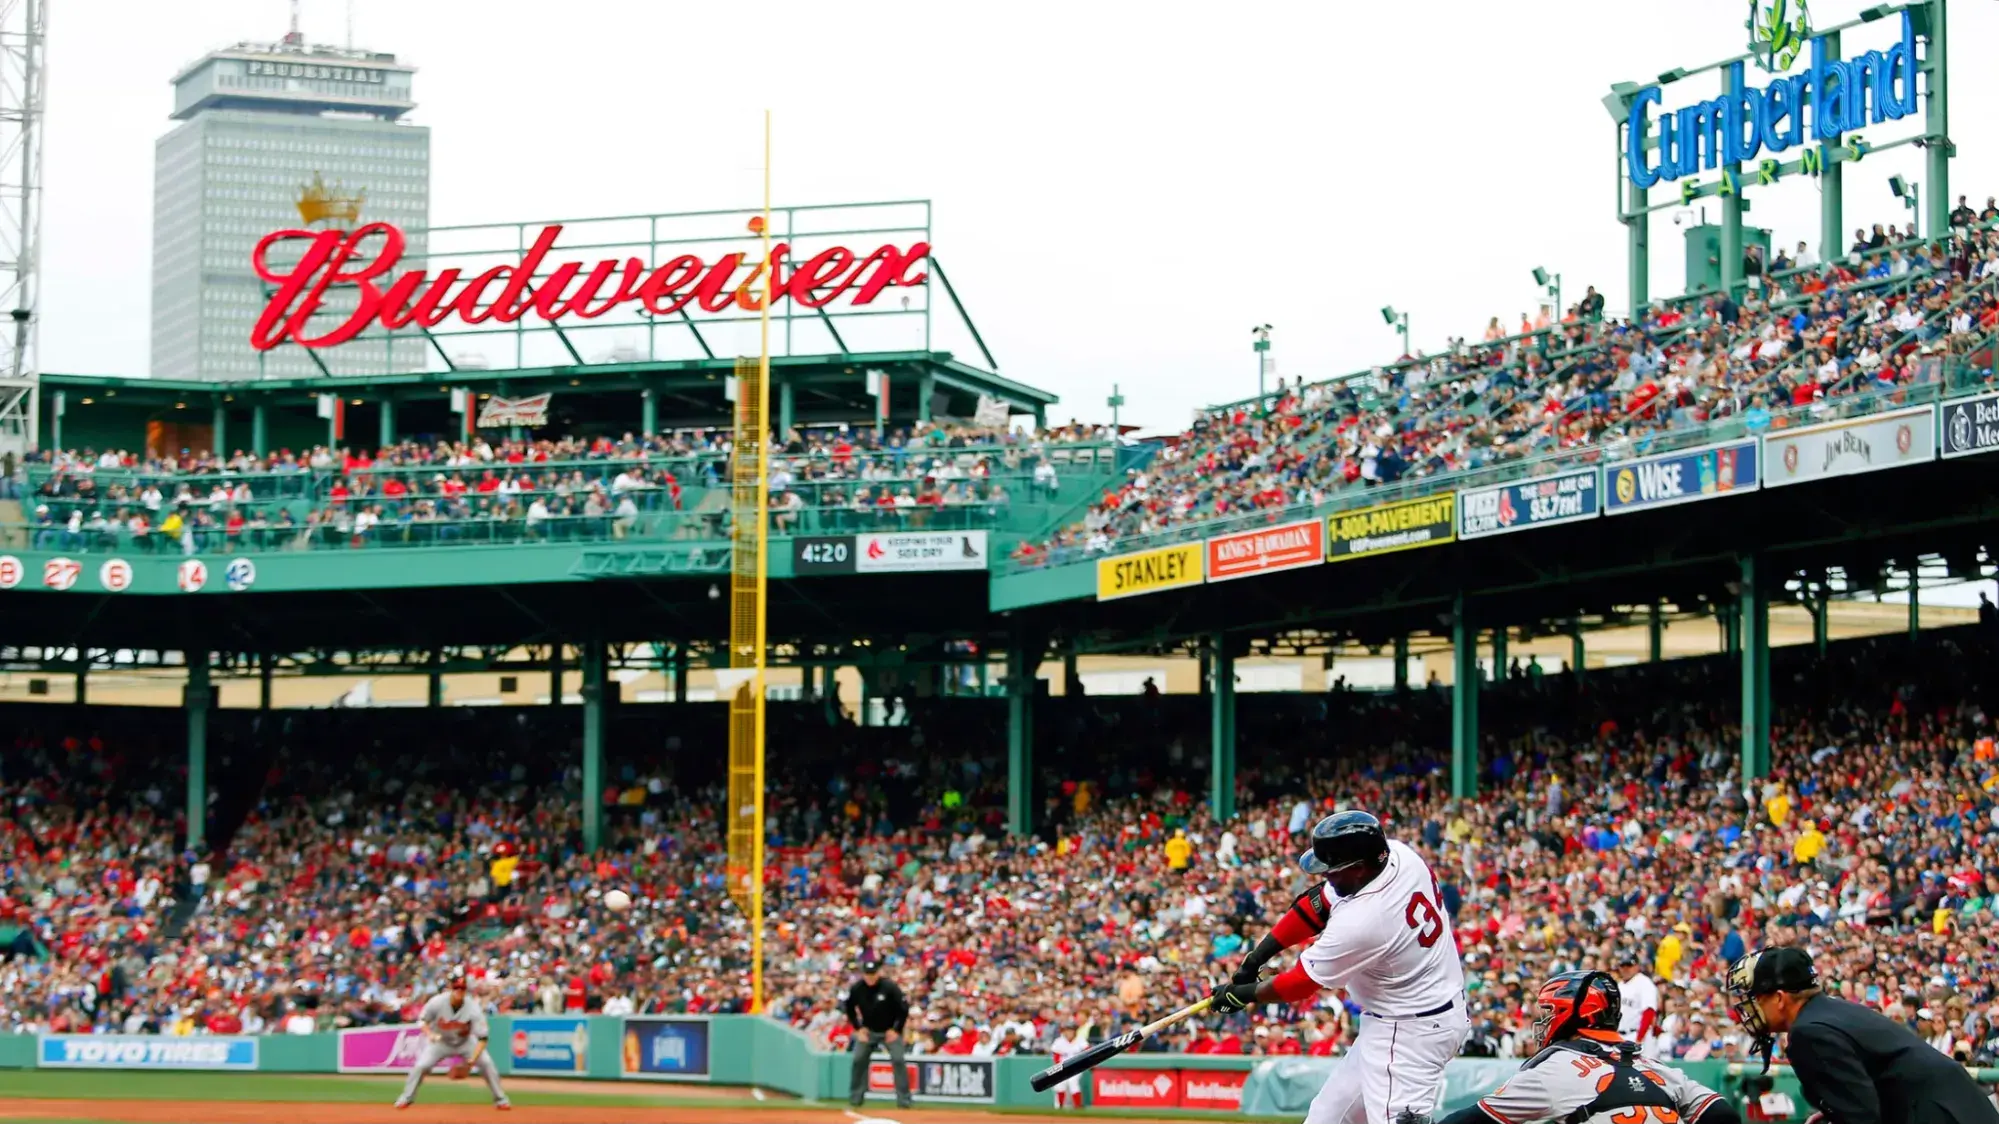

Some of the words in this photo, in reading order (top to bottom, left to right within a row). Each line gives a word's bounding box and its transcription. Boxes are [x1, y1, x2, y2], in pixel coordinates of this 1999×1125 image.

[249, 61, 382, 83] PRUDENTIAL
[1628, 10, 1917, 189] Cumberland
[1682, 135, 1864, 206] FARMS
[250, 218, 931, 351] Budweiser
[1822, 438, 1842, 473] JIM
[1843, 430, 1872, 465] BEAM
[1637, 461, 1684, 501] WISE
[801, 542, 848, 563] 4:20
[44, 560, 83, 586] 27
[109, 565, 125, 588] 6
[178, 565, 203, 589] 14
[225, 564, 250, 587] 42
[1115, 552, 1189, 590] STANLEY
[63, 1041, 148, 1063] TOYO
[149, 1041, 231, 1063] TIRES
